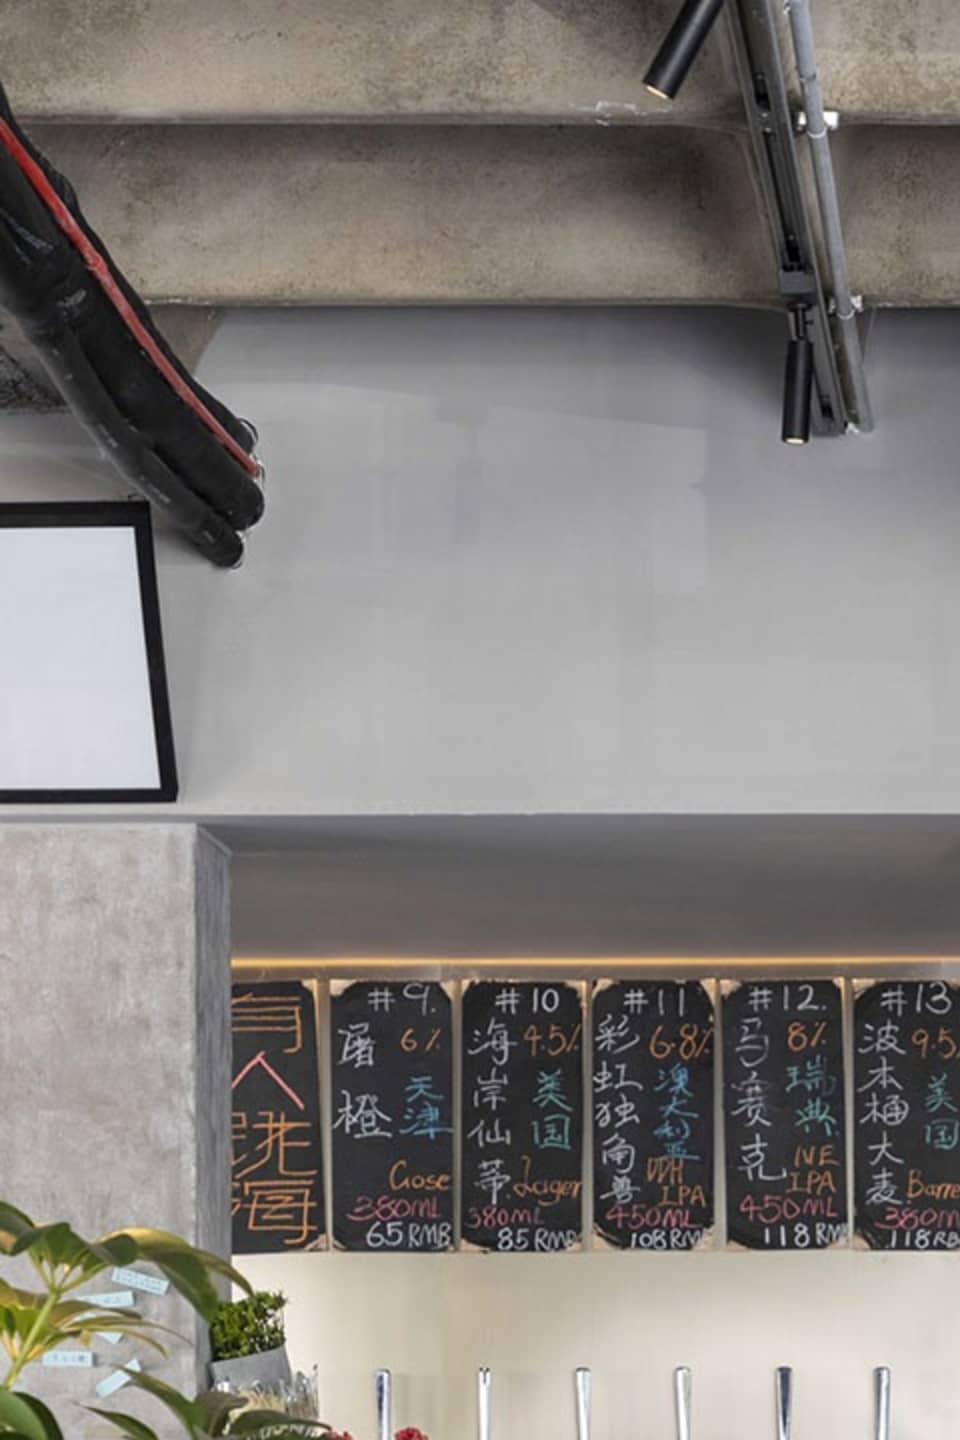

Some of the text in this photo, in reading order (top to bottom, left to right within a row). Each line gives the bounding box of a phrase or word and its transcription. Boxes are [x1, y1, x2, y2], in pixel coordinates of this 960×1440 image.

[400, 1027, 442, 1051] 6%
[787, 1021, 828, 1051] 8%
[399, 1075, 455, 1140] 天津
[532, 1069, 573, 1150] 美国
[858, 1018, 910, 1206] 波本桶大麦
[923, 1072, 960, 1149] 美国
